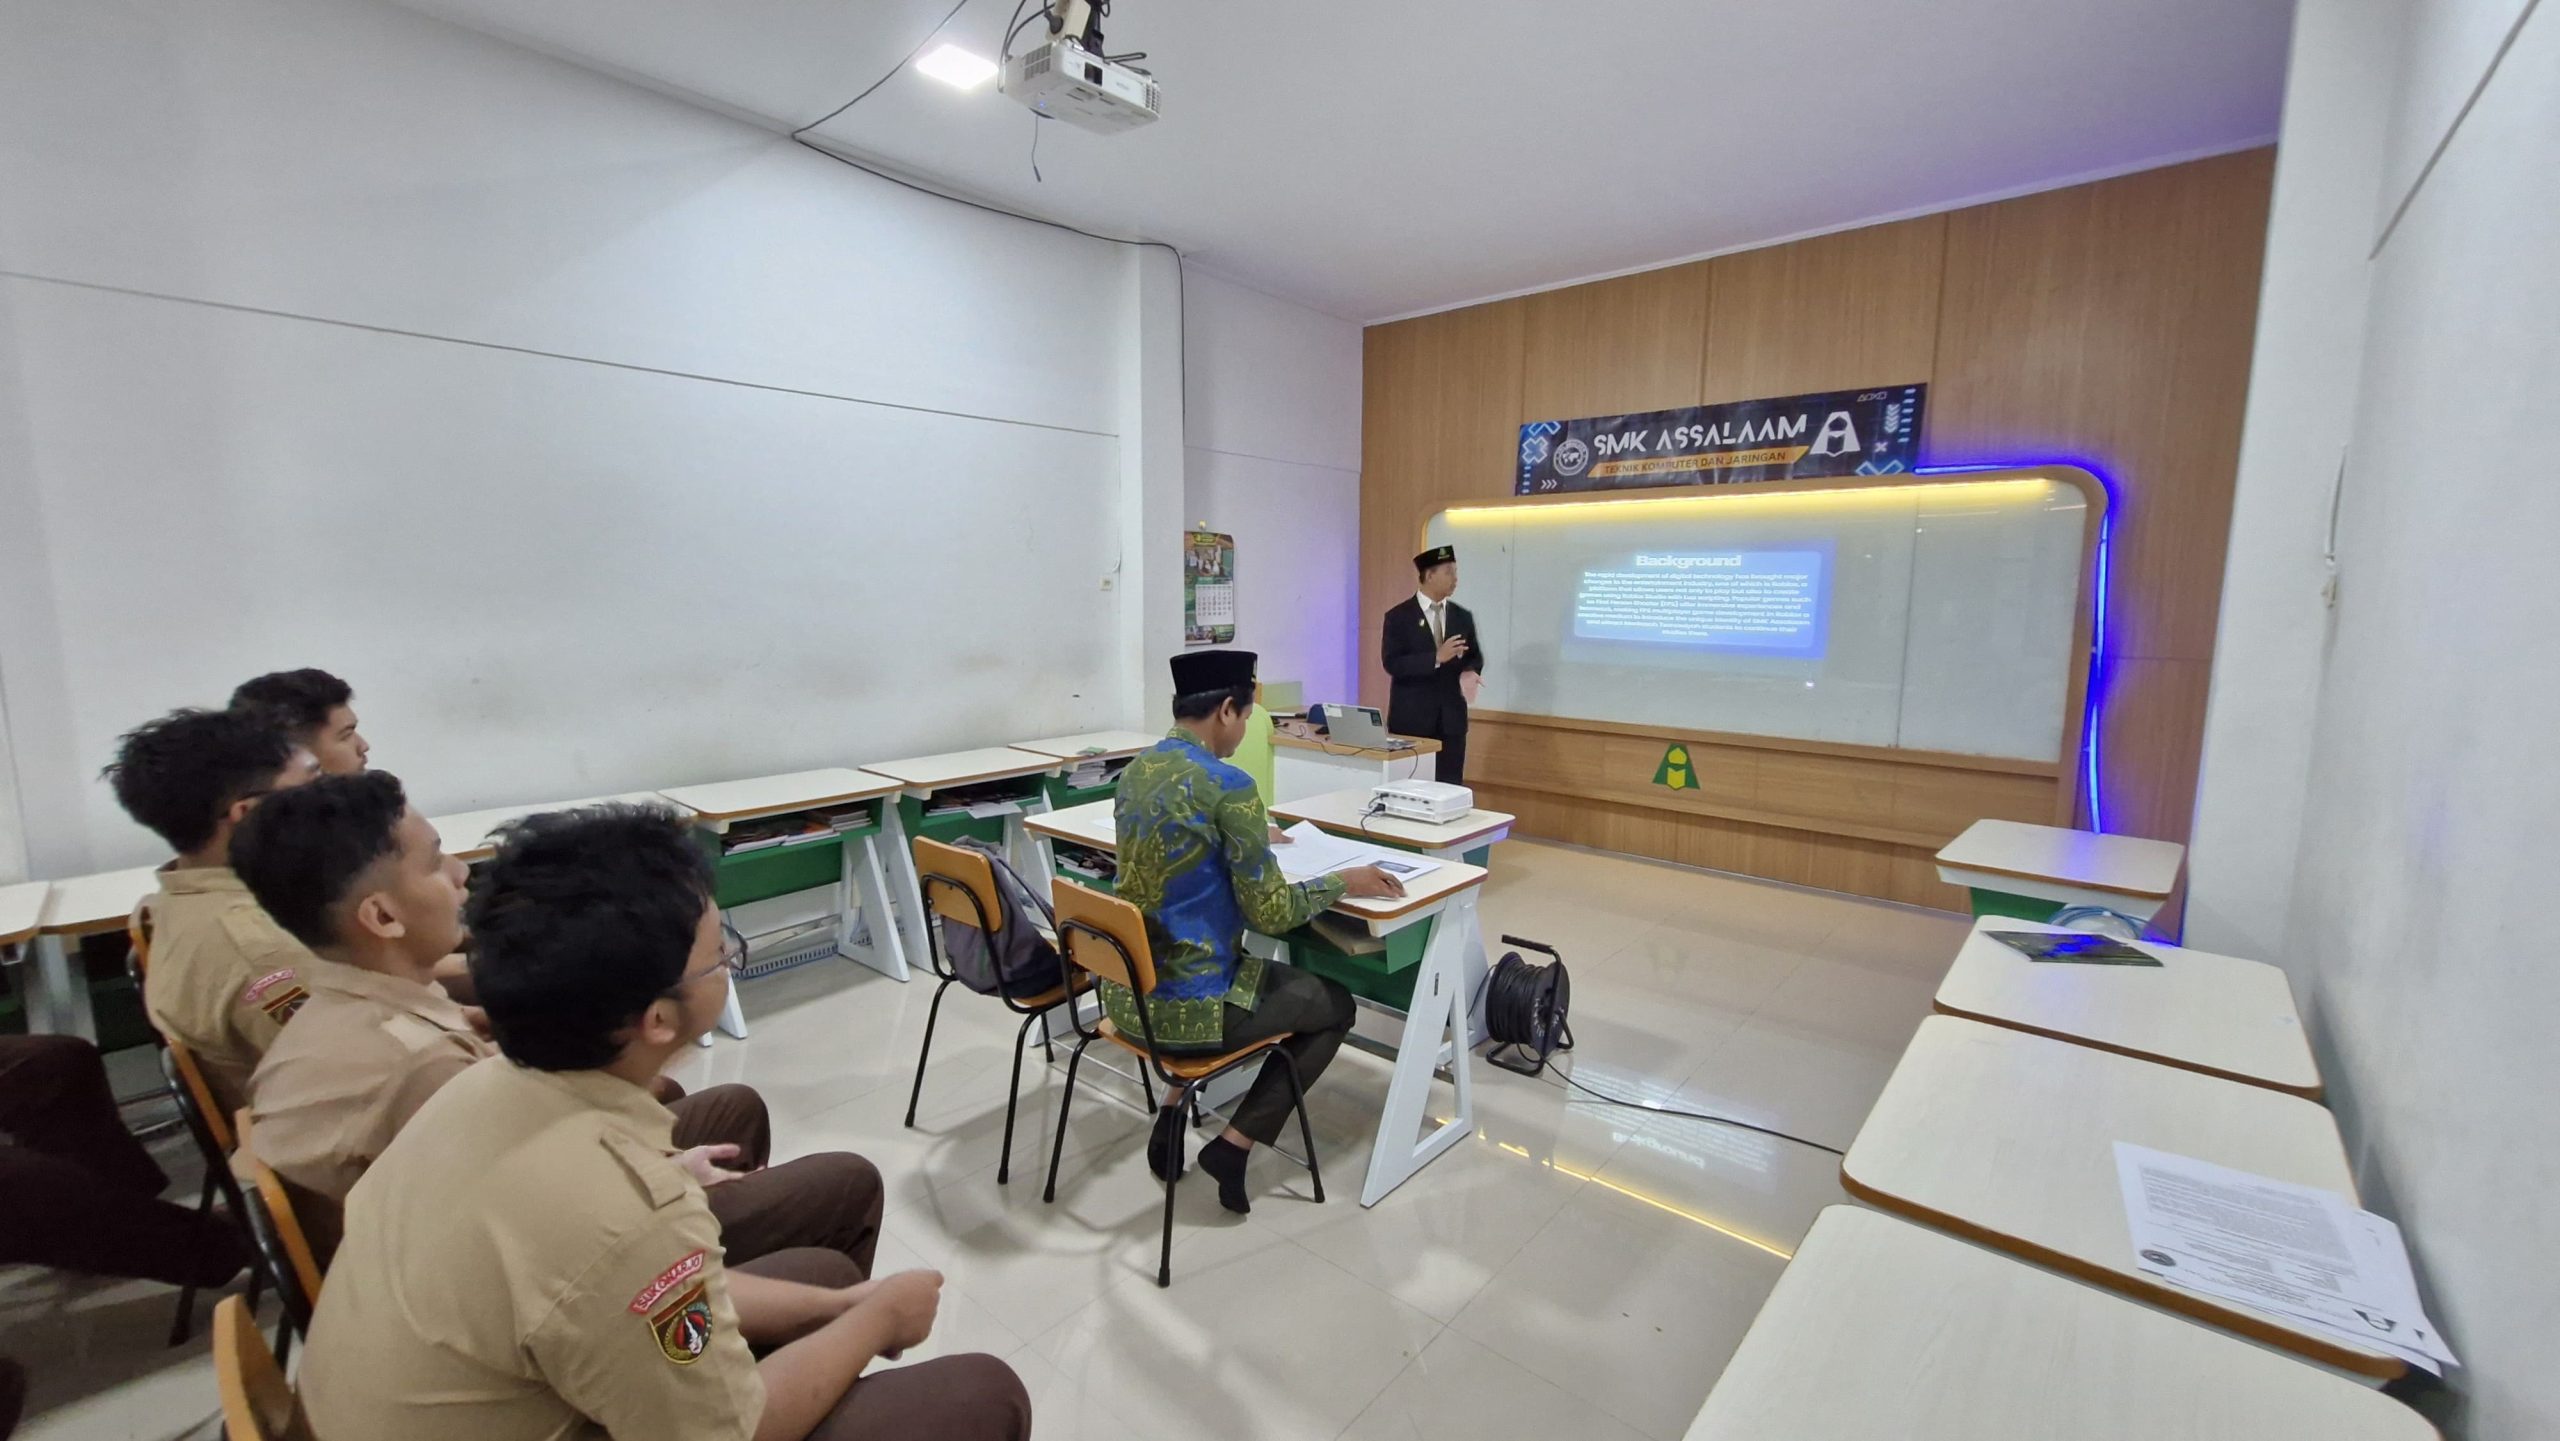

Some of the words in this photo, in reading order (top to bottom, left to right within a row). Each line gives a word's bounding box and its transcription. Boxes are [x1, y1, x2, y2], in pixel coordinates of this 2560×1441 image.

[1594, 430, 1648, 456] SMK
[1656, 414, 1807, 451] ASSALAAM
[1605, 464, 1640, 474] TEKNIK
[1700, 456, 1724, 467] DAN
[1726, 451, 1786, 465] JARINGAN
[1636, 555, 1742, 569] Background
